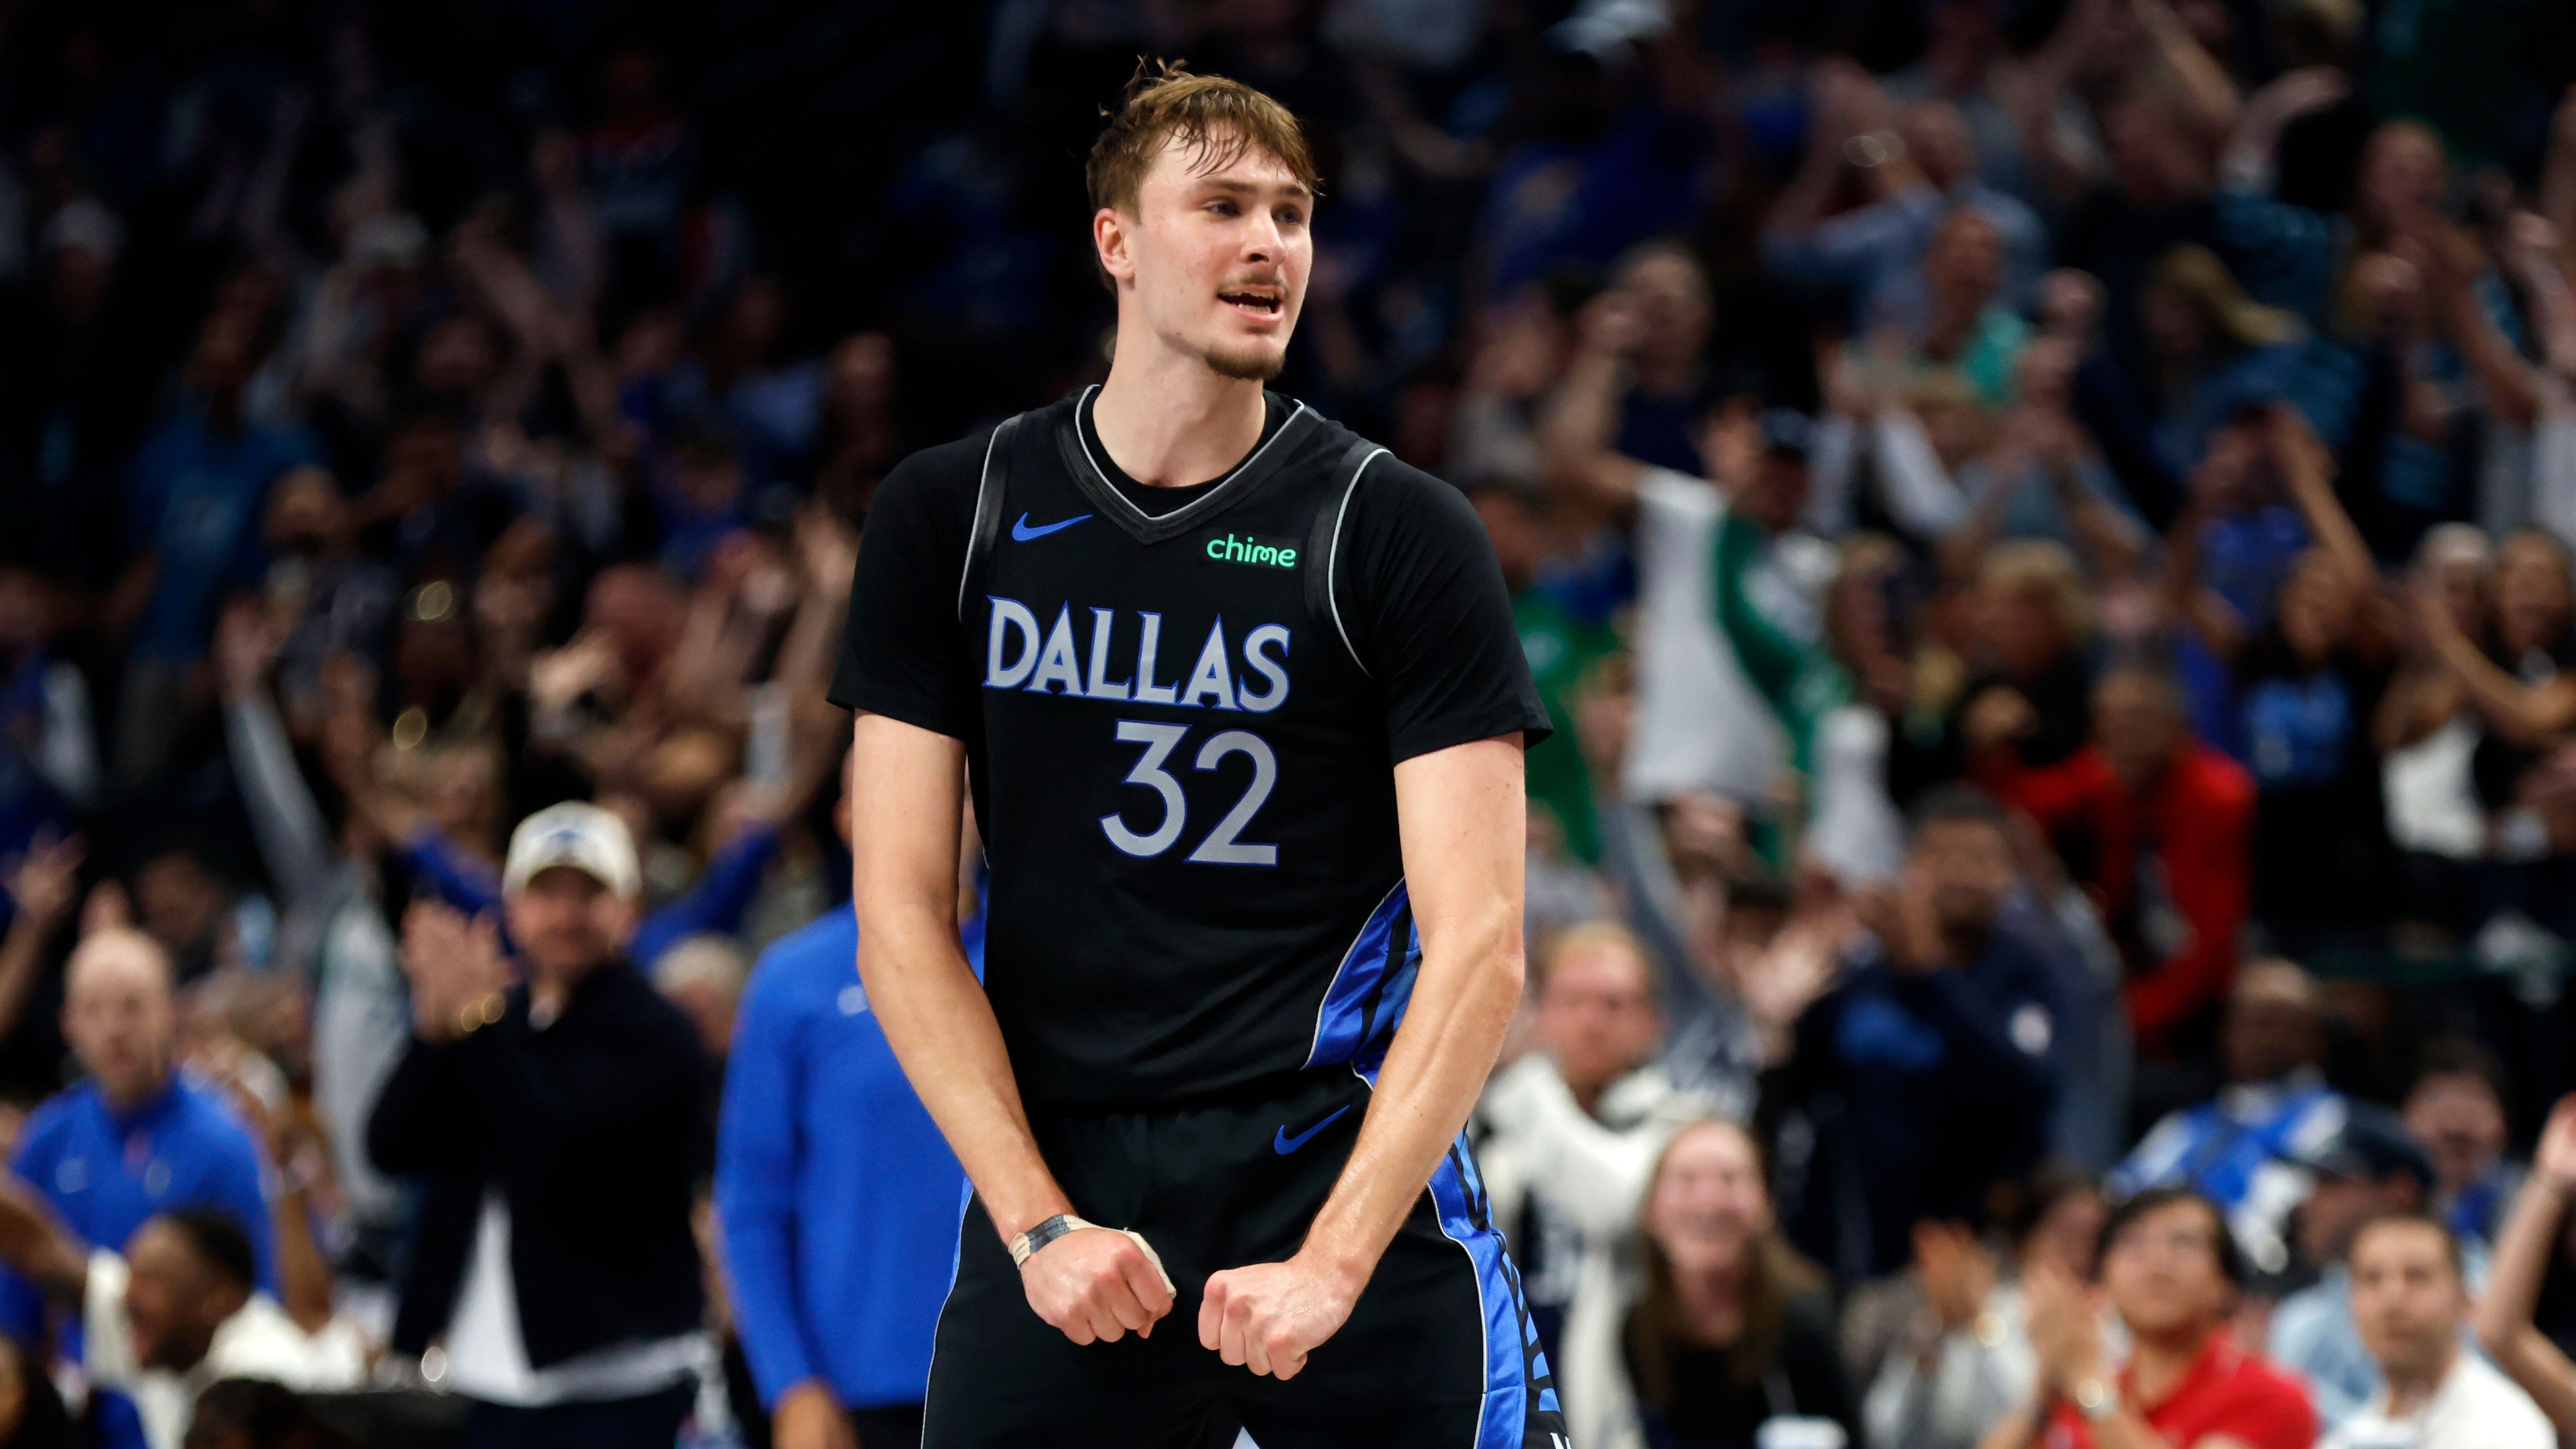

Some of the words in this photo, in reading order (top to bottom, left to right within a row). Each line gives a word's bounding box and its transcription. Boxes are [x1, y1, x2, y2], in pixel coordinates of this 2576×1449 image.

[1207, 533, 1296, 568] chime
[981, 595, 1291, 713] DALLAS
[1098, 718, 1279, 867] 32
